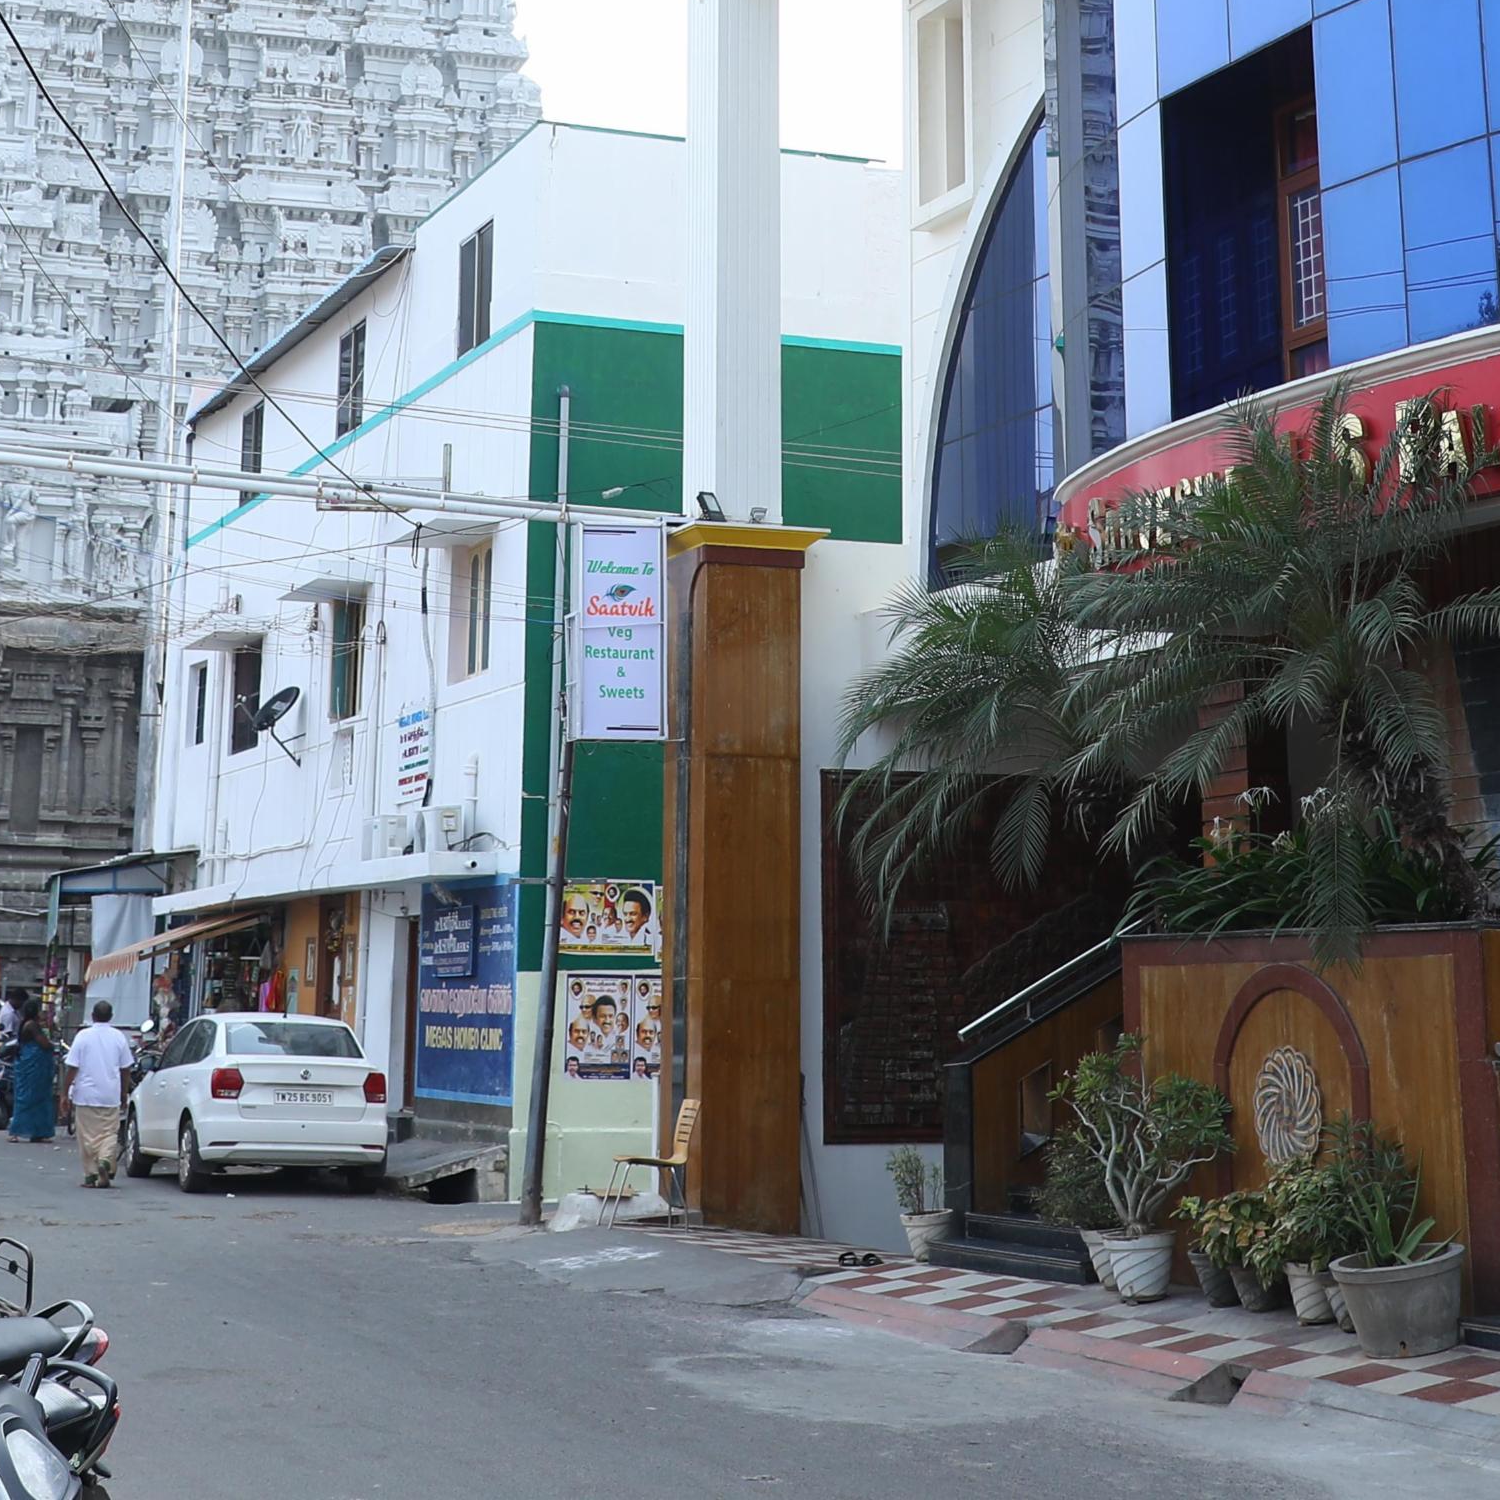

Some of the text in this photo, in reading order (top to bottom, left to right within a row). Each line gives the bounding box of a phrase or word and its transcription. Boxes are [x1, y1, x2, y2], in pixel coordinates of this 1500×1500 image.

[586, 559, 655, 576] Welcome To
[586, 595, 656, 618] Saatvik
[608, 626, 633, 641] Veg
[585, 644, 655, 660] Restaurant
[616, 666, 626, 678] &
[599, 684, 645, 699] Sweets
[424, 1024, 503, 1051] MEGAS HOMEO CLINIC
